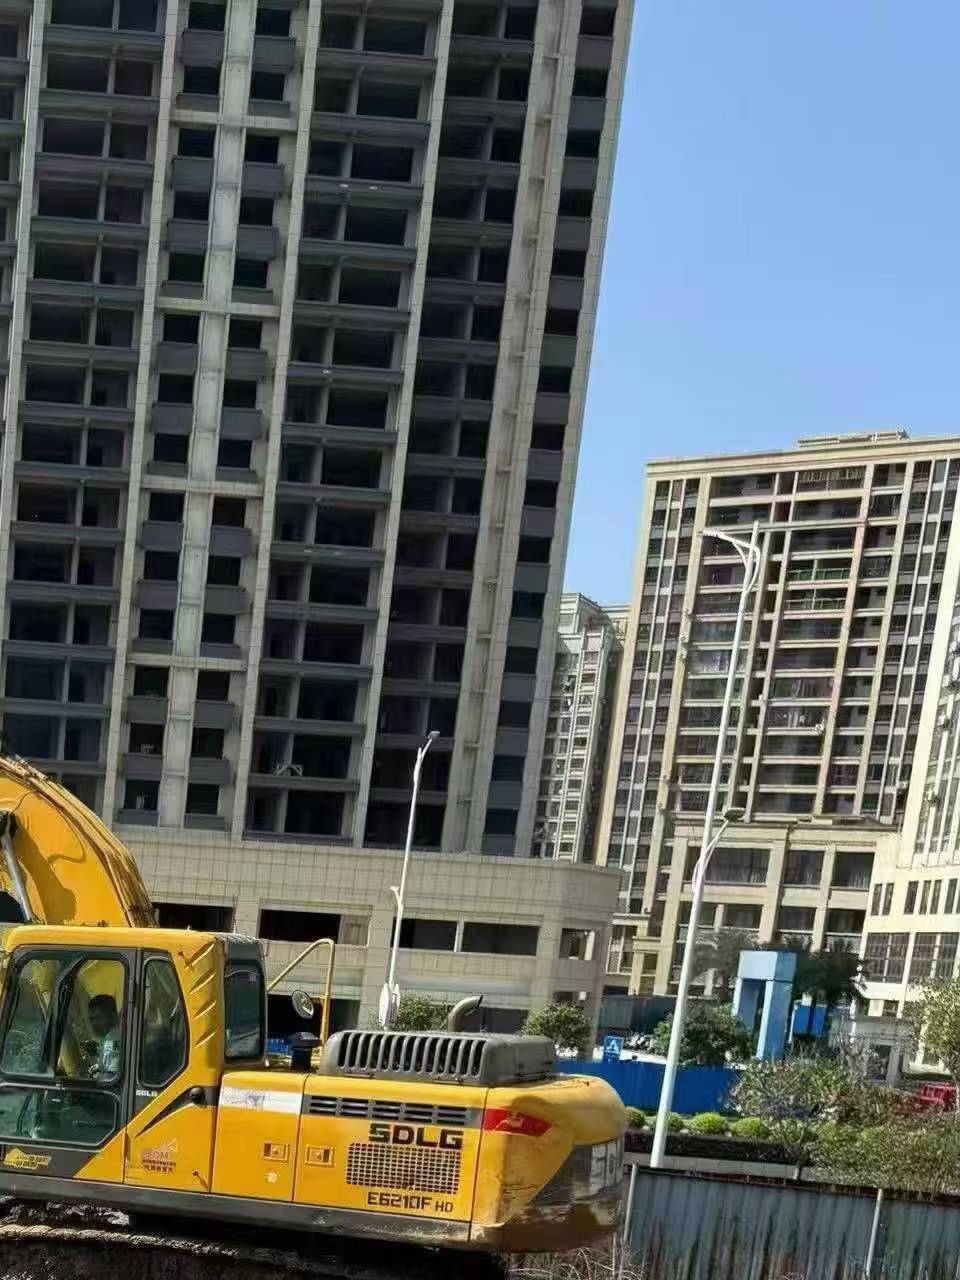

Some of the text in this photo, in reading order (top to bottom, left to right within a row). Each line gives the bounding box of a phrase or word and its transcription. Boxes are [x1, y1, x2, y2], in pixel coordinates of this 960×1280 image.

[368, 1123, 464, 1149] SDLG
[367, 1191, 454, 1213] E6210F HD
